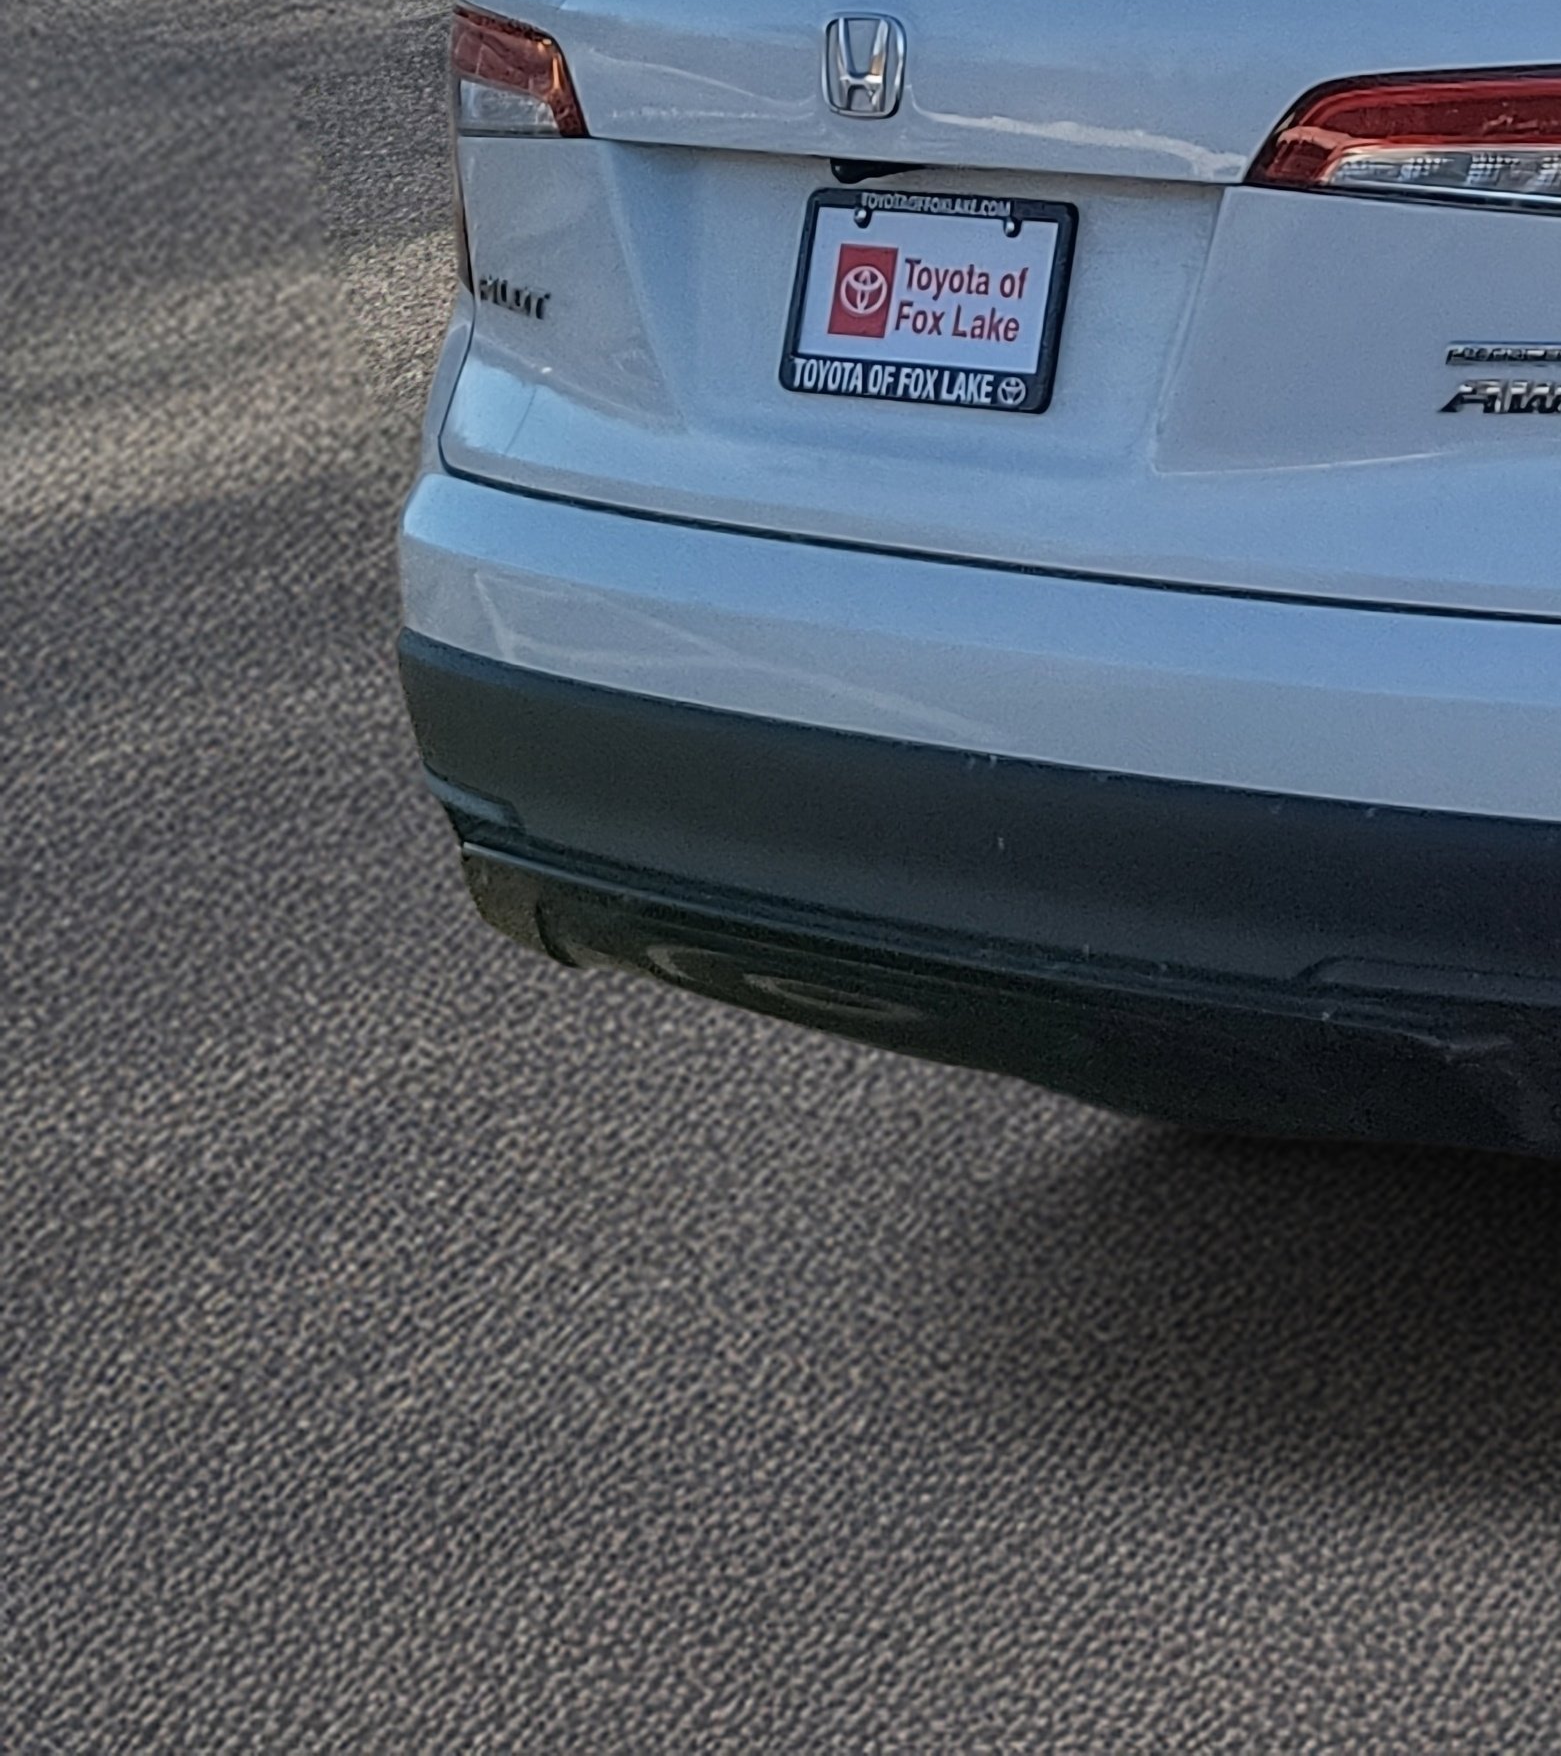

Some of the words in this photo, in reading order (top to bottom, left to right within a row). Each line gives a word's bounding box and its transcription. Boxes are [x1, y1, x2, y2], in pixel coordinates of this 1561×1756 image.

[905, 257, 990, 301] Toyota
[1000, 267, 1029, 299] of
[895, 300, 945, 336] Fox
[952, 304, 1020, 342] Lake
[793, 358, 862, 393] TOYOTA
[867, 365, 896, 396] OF
[899, 366, 939, 400] FOX
[940, 370, 994, 404] LAKE
